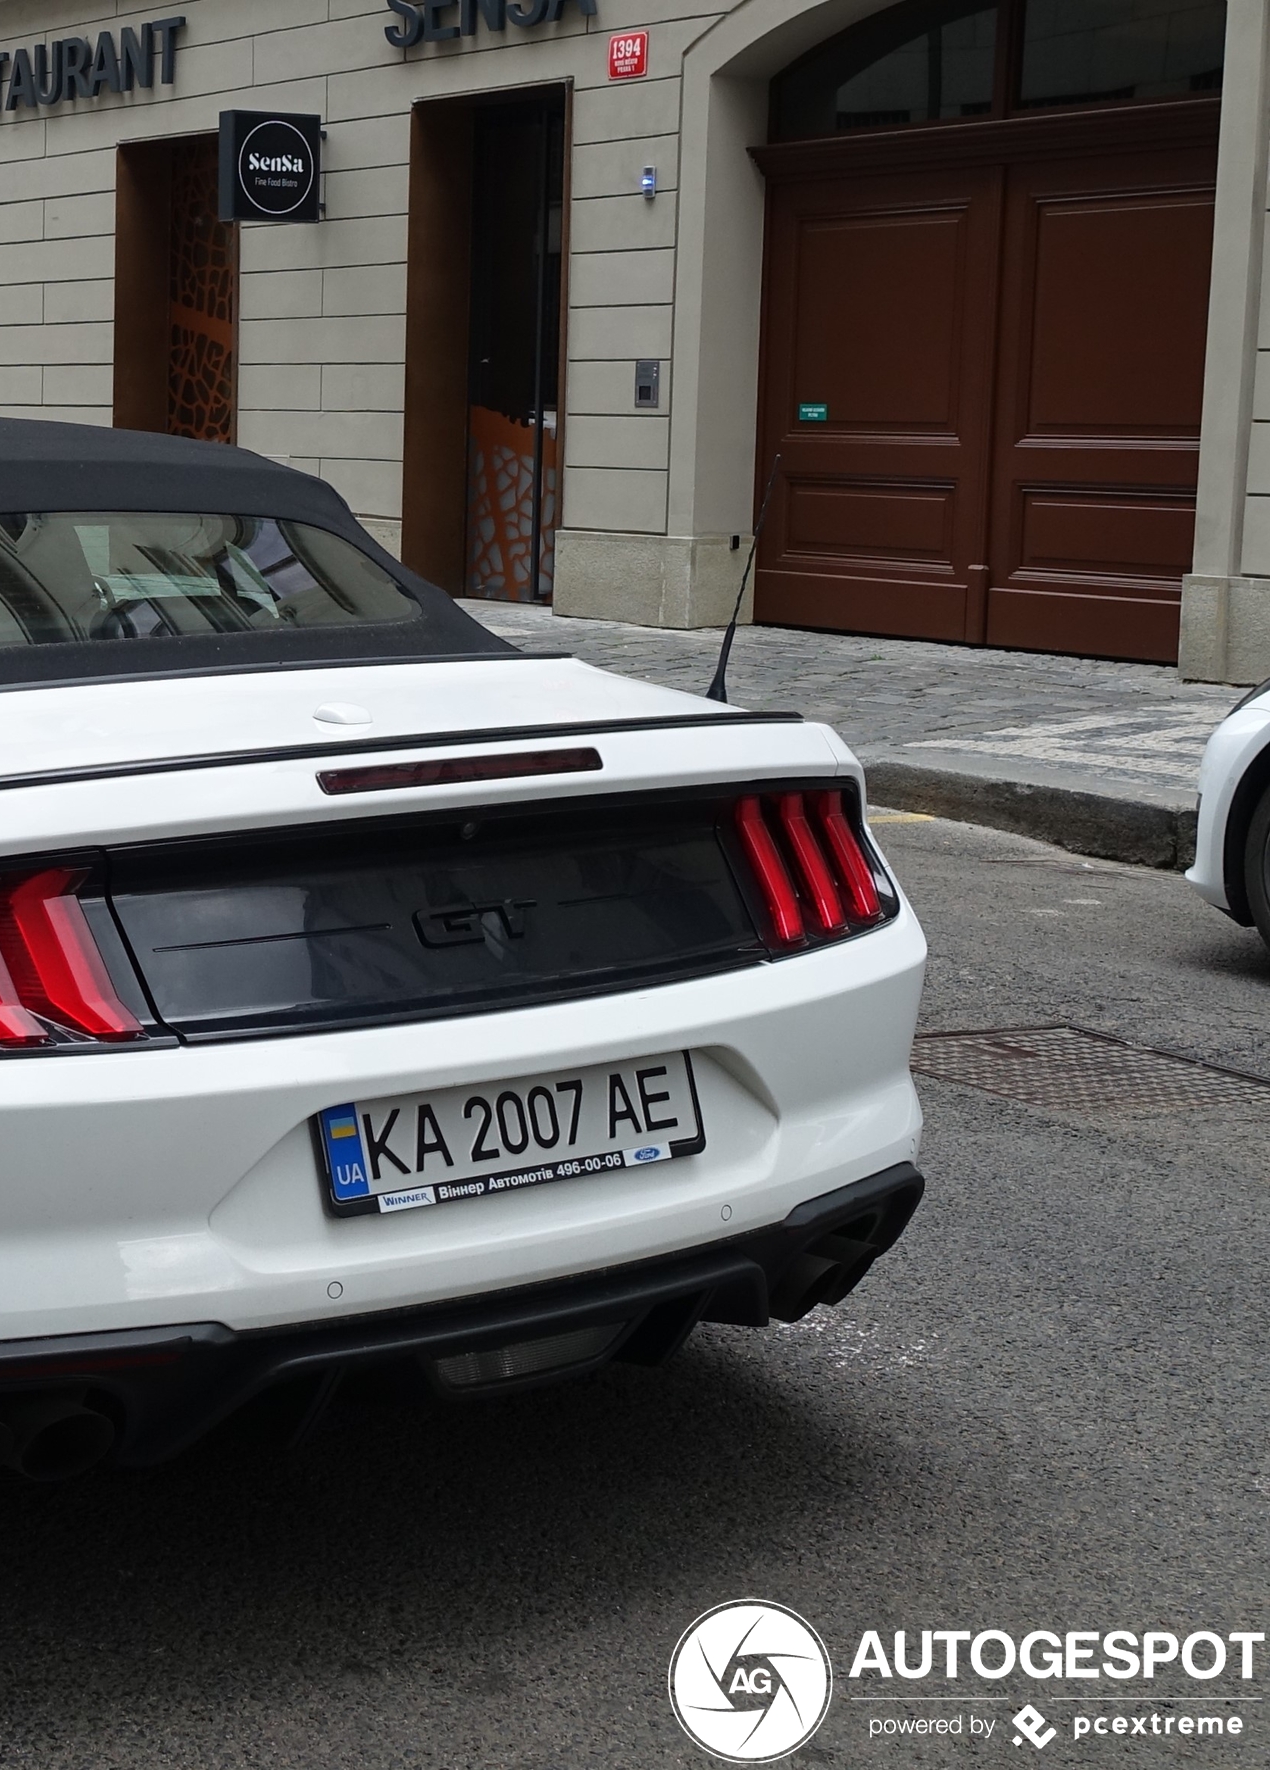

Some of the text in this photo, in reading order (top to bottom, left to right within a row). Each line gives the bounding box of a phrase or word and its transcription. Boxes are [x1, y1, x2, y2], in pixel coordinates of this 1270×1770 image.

[612, 38, 641, 59] 1394
[248, 152, 304, 173] SenSa
[254, 177, 298, 188] Fine Food Bistro
[411, 900, 538, 949] GT
[362, 1066, 678, 1179] KA 2007 AE
[336, 1163, 364, 1185] UA
[438, 1153, 622, 1200] Віннер Автомотів 496-00-06
[382, 1191, 432, 1207] WINNER
